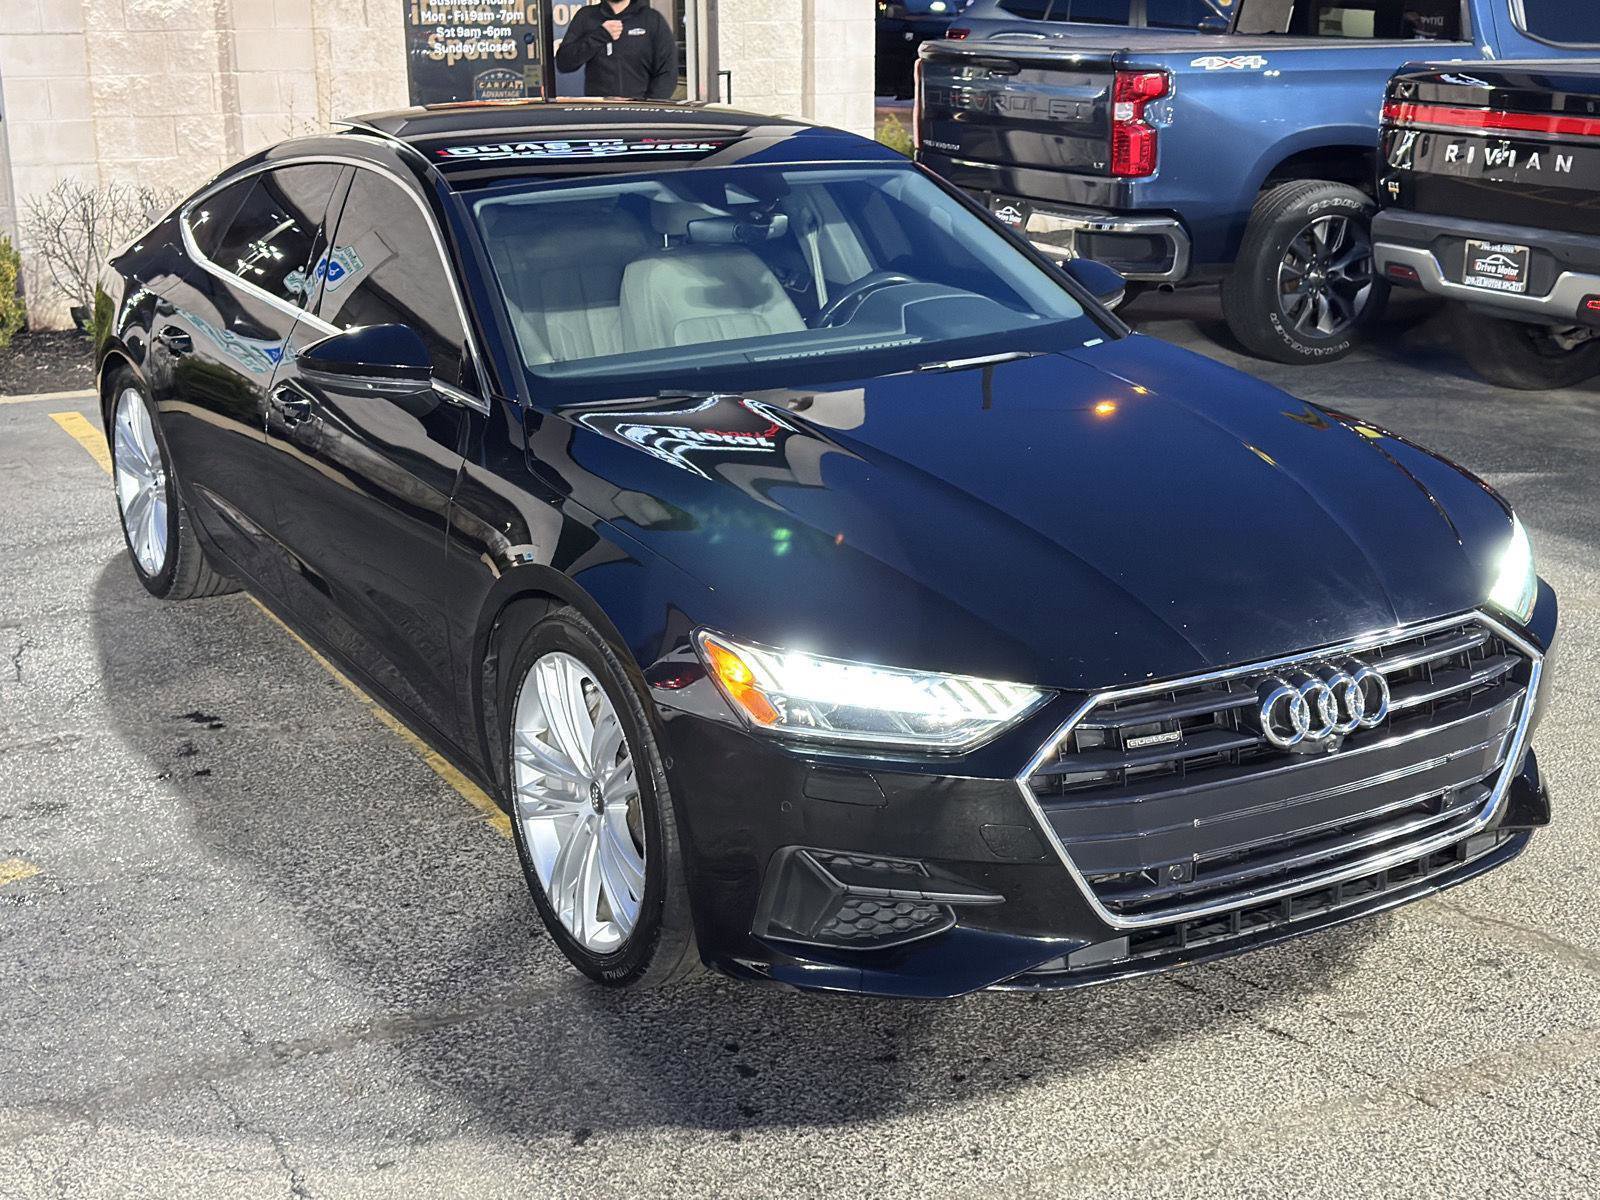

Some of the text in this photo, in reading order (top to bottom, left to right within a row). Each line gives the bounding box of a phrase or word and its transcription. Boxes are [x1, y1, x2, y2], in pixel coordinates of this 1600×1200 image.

[421, 10, 447, 22] Mon
[469, 10, 495, 22] 9am
[436, 27, 455, 38] Sat
[456, 27, 481, 38] 9am
[434, 43, 475, 54] Sunday
[477, 41, 515, 52] Closed
[1445, 144, 1573, 173] RIVIAN
